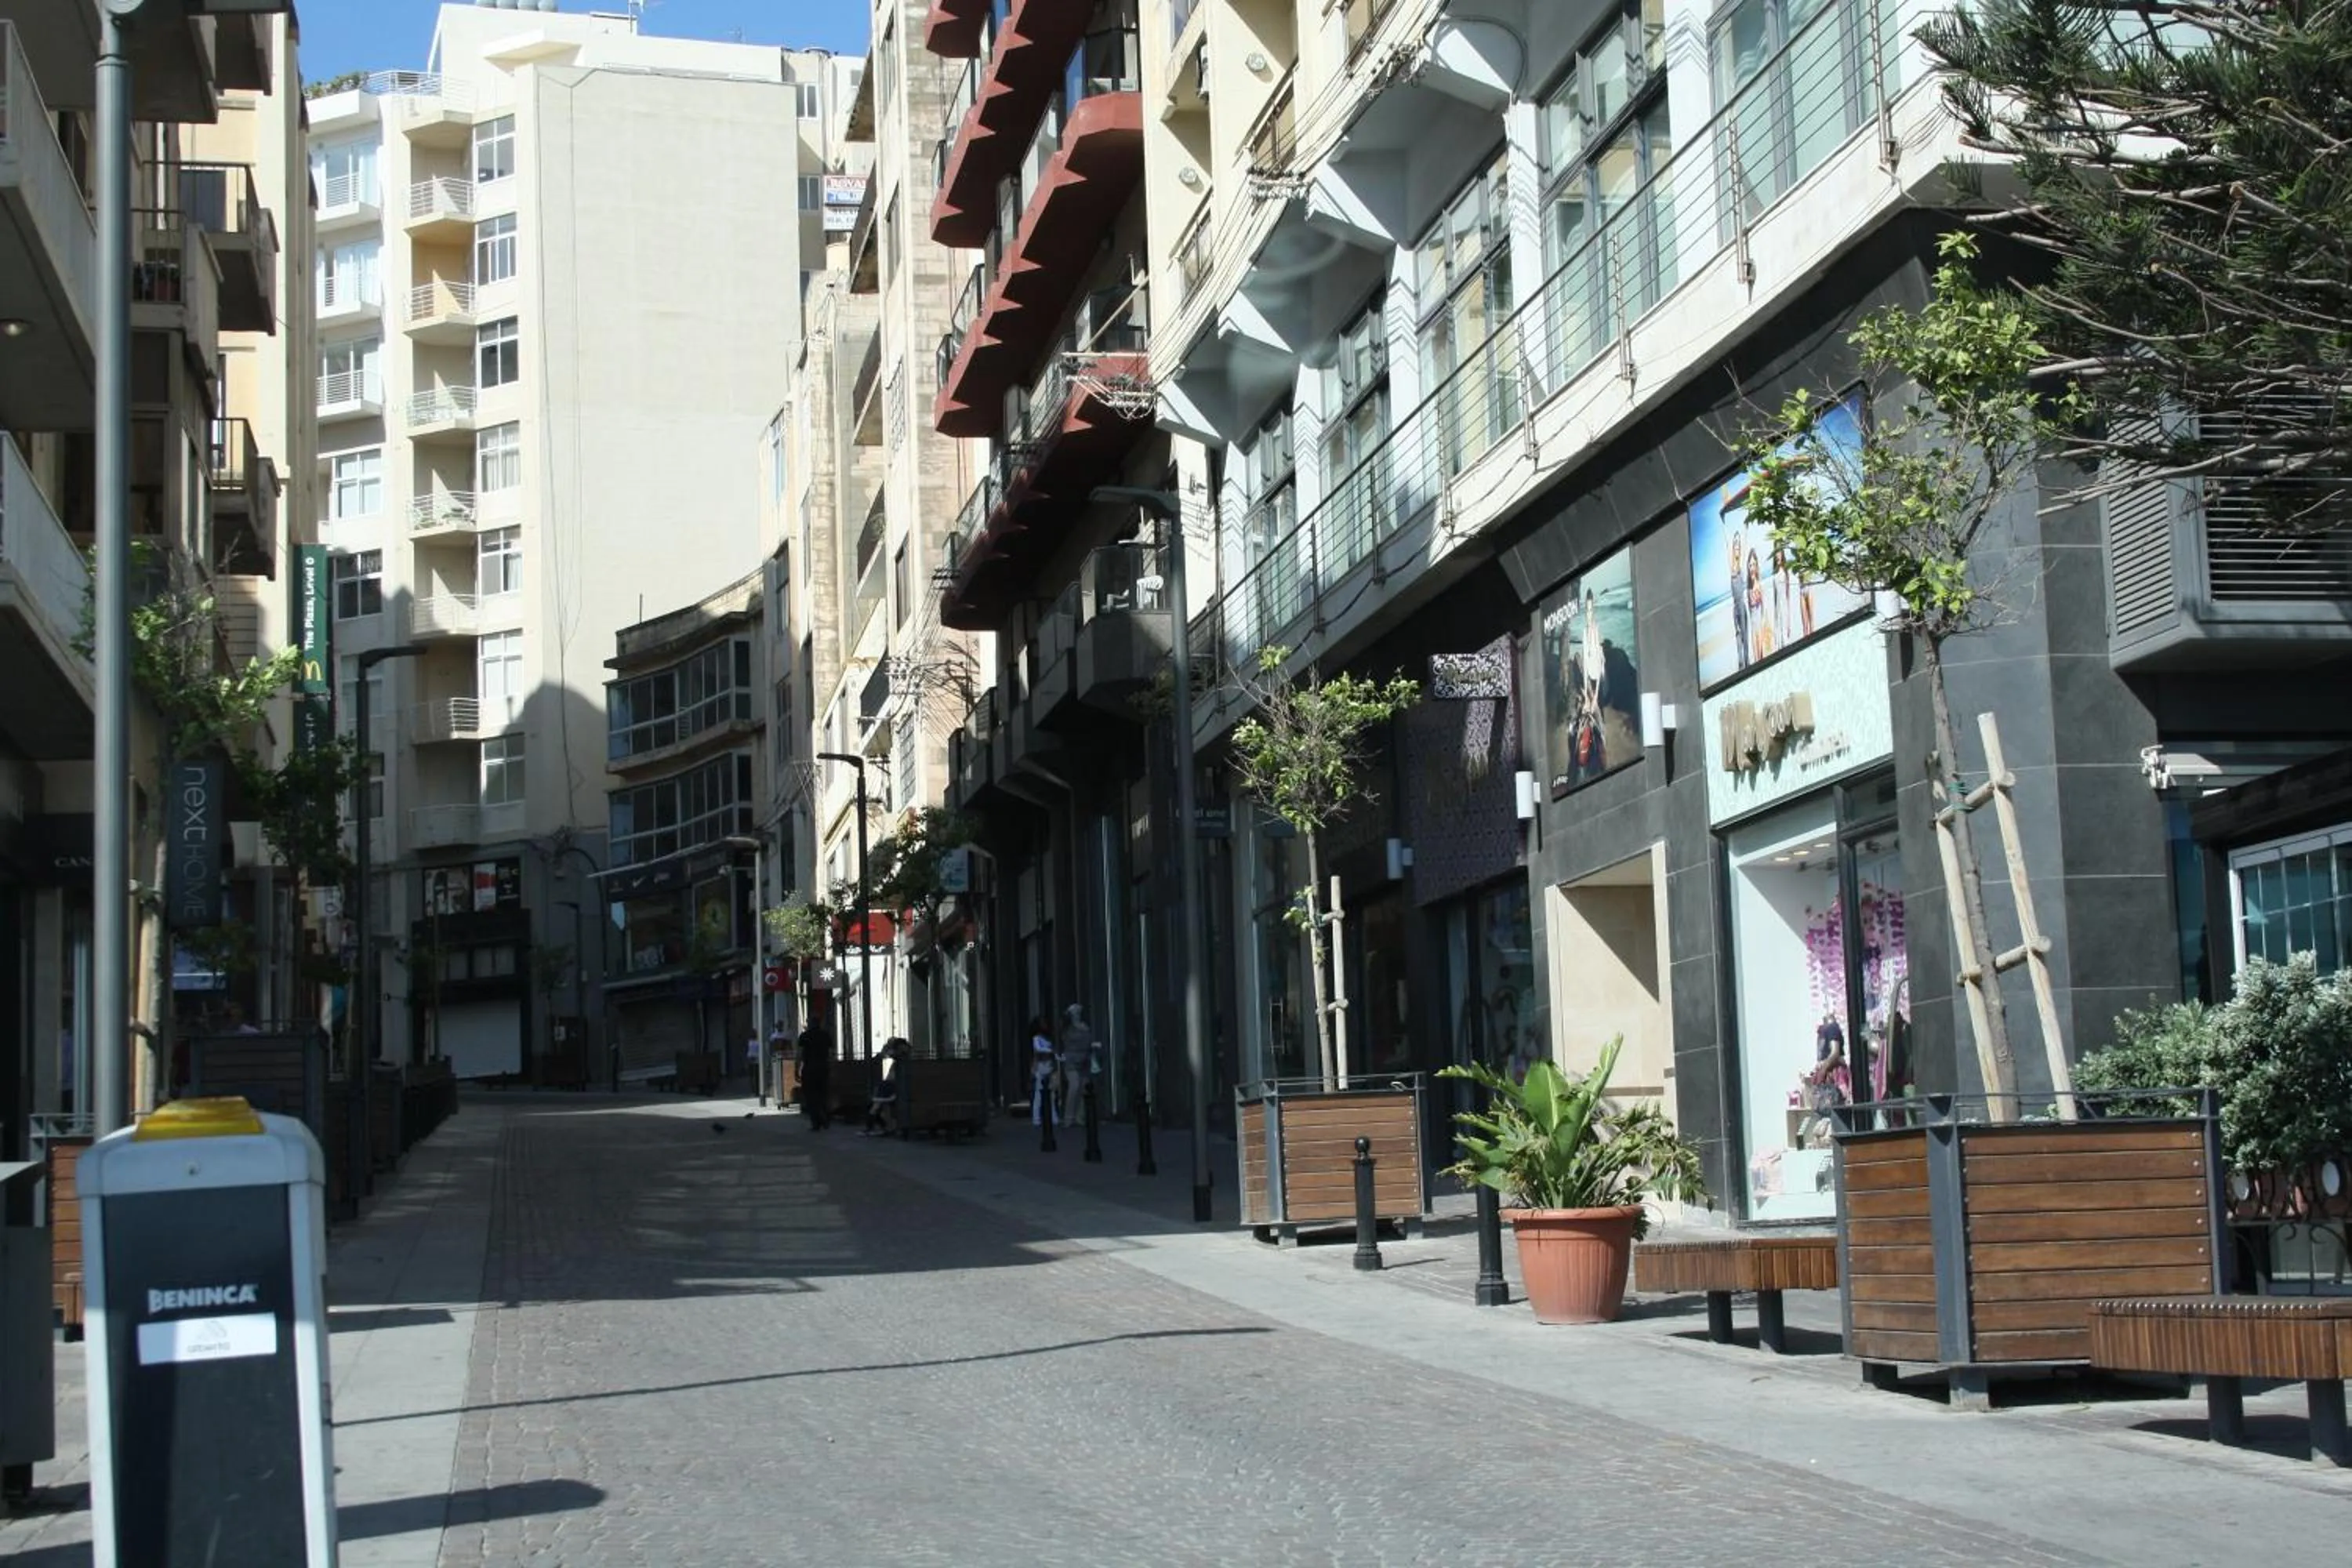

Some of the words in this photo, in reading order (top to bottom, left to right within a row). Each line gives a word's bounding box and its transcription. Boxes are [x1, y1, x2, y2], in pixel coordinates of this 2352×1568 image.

[304, 567, 314, 595] Level
[304, 629, 314, 651] The
[183, 766, 207, 840] next
[183, 844, 207, 918] HOME
